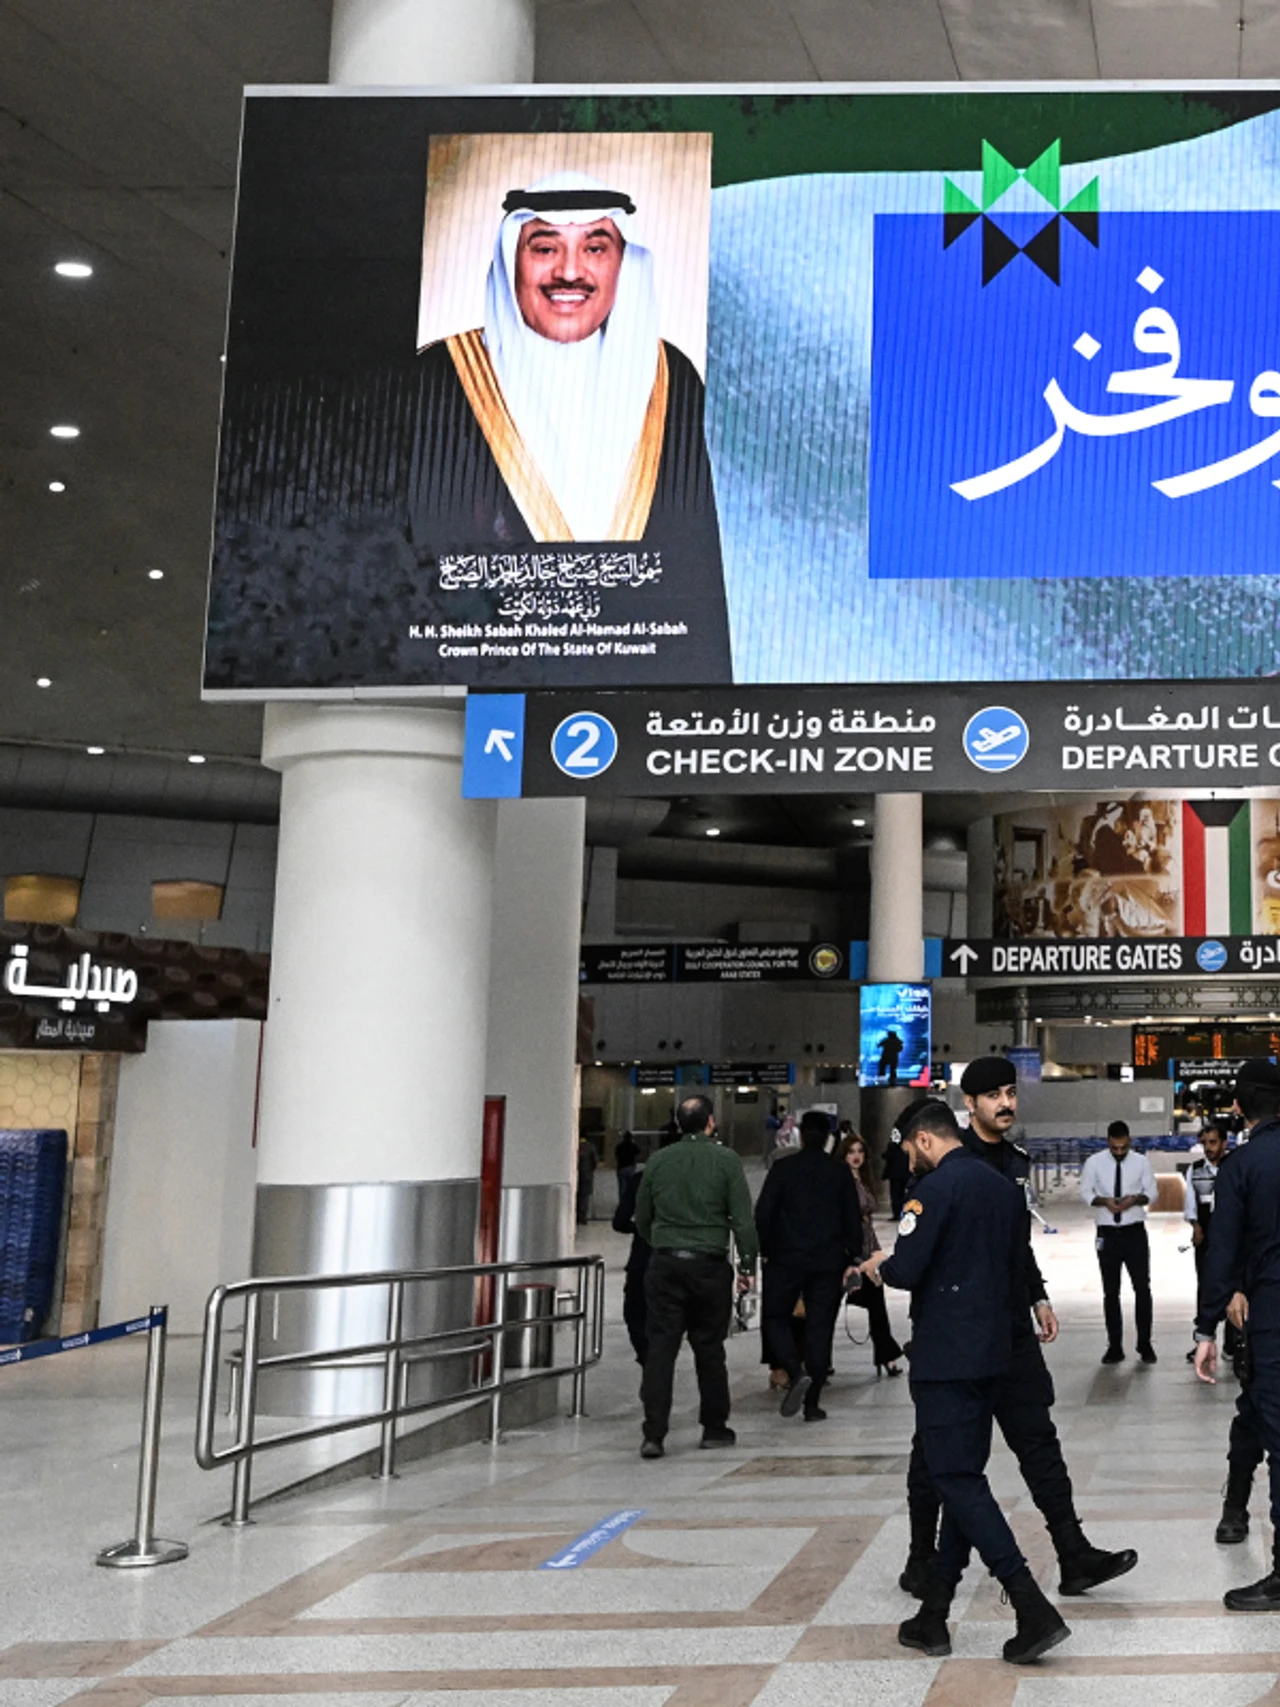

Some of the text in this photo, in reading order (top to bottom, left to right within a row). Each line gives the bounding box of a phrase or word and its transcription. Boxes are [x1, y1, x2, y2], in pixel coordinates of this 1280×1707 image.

[439, 623, 483, 639] Sheikh
[484, 623, 524, 638] Sabah
[524, 622, 569, 638] Khaled
[569, 621, 631, 637] Al-Hamad
[631, 620, 688, 636] Al-Sabah
[437, 640, 657, 658] Crown Prince Of The State Of Kuwait
[645, 708, 937, 742] منطقة وزن الأمتعة
[1063, 704, 1221, 737] المغادرة
[564, 719, 601, 769] 2
[1061, 742, 1260, 771] DEPARTURE
[646, 746, 934, 776] CHECK-IN ZONE
[992, 943, 1183, 973] DEPARTURE GATES
[6, 944, 138, 1013] صيدلية
